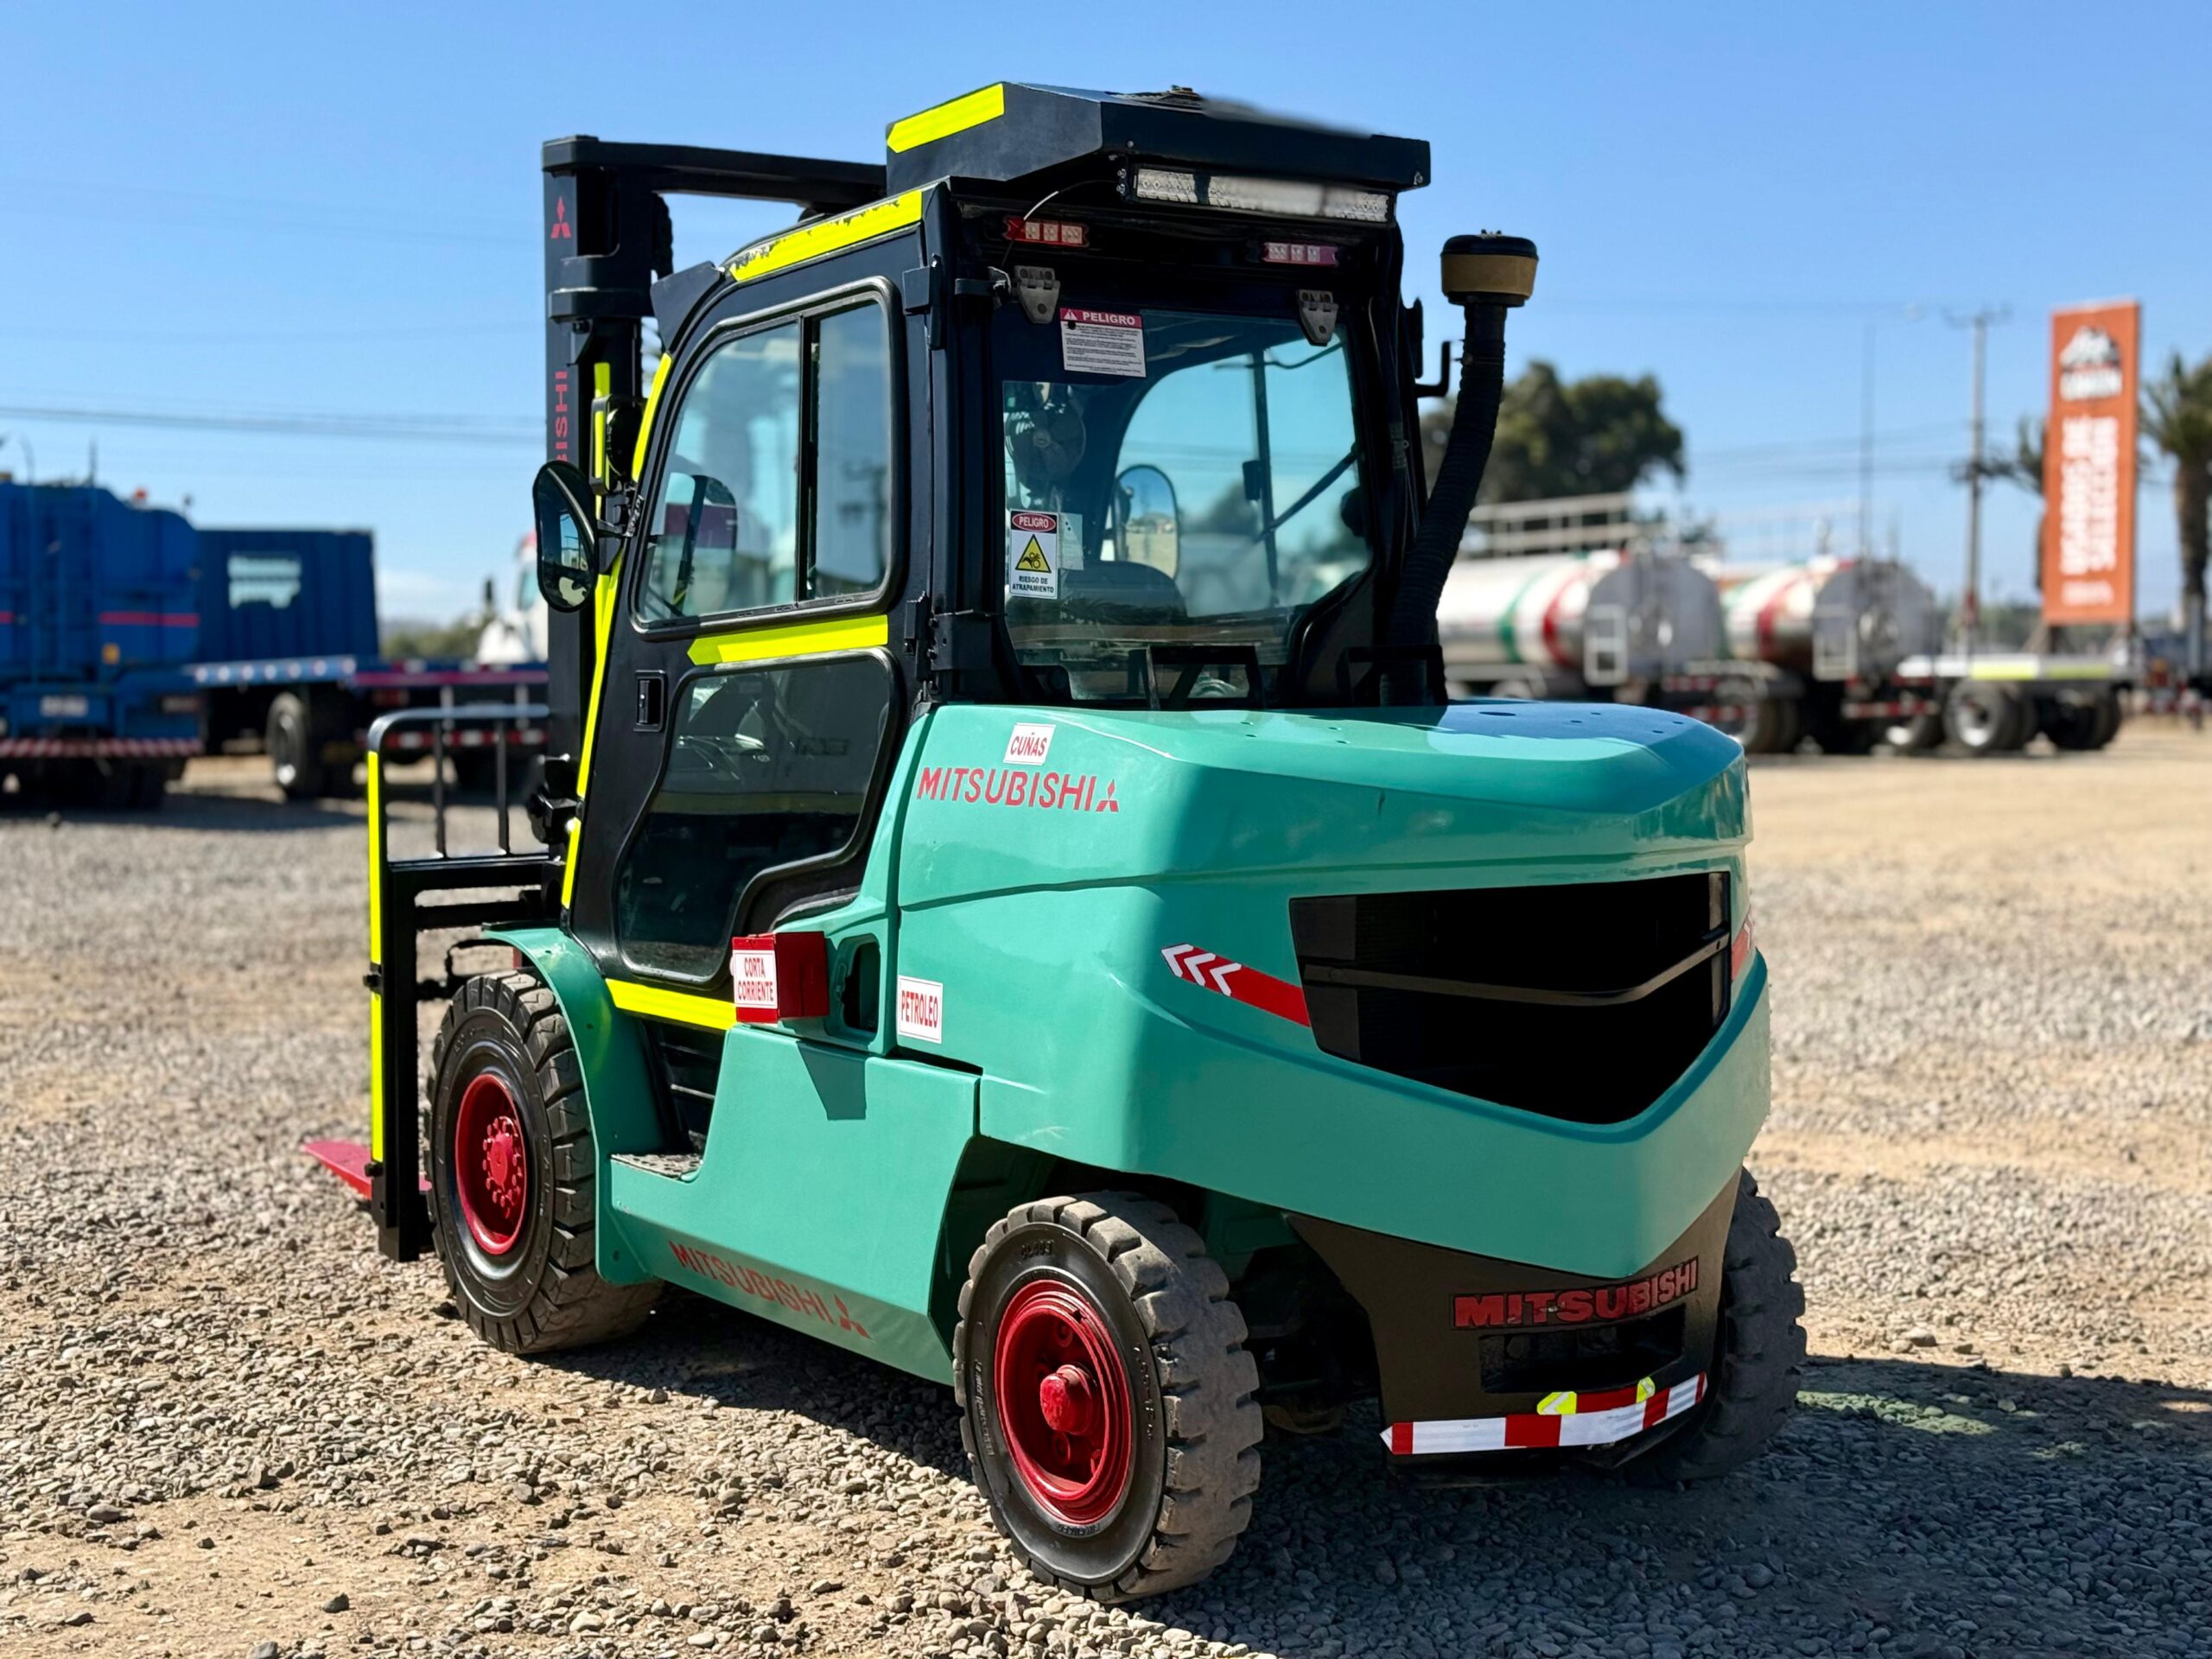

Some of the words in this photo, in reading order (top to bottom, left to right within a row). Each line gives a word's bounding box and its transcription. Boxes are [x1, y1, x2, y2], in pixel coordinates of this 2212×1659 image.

[1082, 311, 1135, 326] PELIGRO
[1019, 516, 1049, 529] PELIGRO
[1012, 583, 1054, 594] ATRAPAMIENTO
[1019, 575, 1039, 584] RIESGO
[1010, 732, 1048, 757] CUÑAS
[917, 767, 1096, 812] MITSUBISHI
[745, 957, 766, 978] CORTA
[737, 981, 773, 1002] CORRIENTE
[900, 990, 938, 1029] PETROLEO
[667, 1240, 835, 1325] MITSUBISHI
[1454, 1257, 1697, 1328] MITSUBISHI
